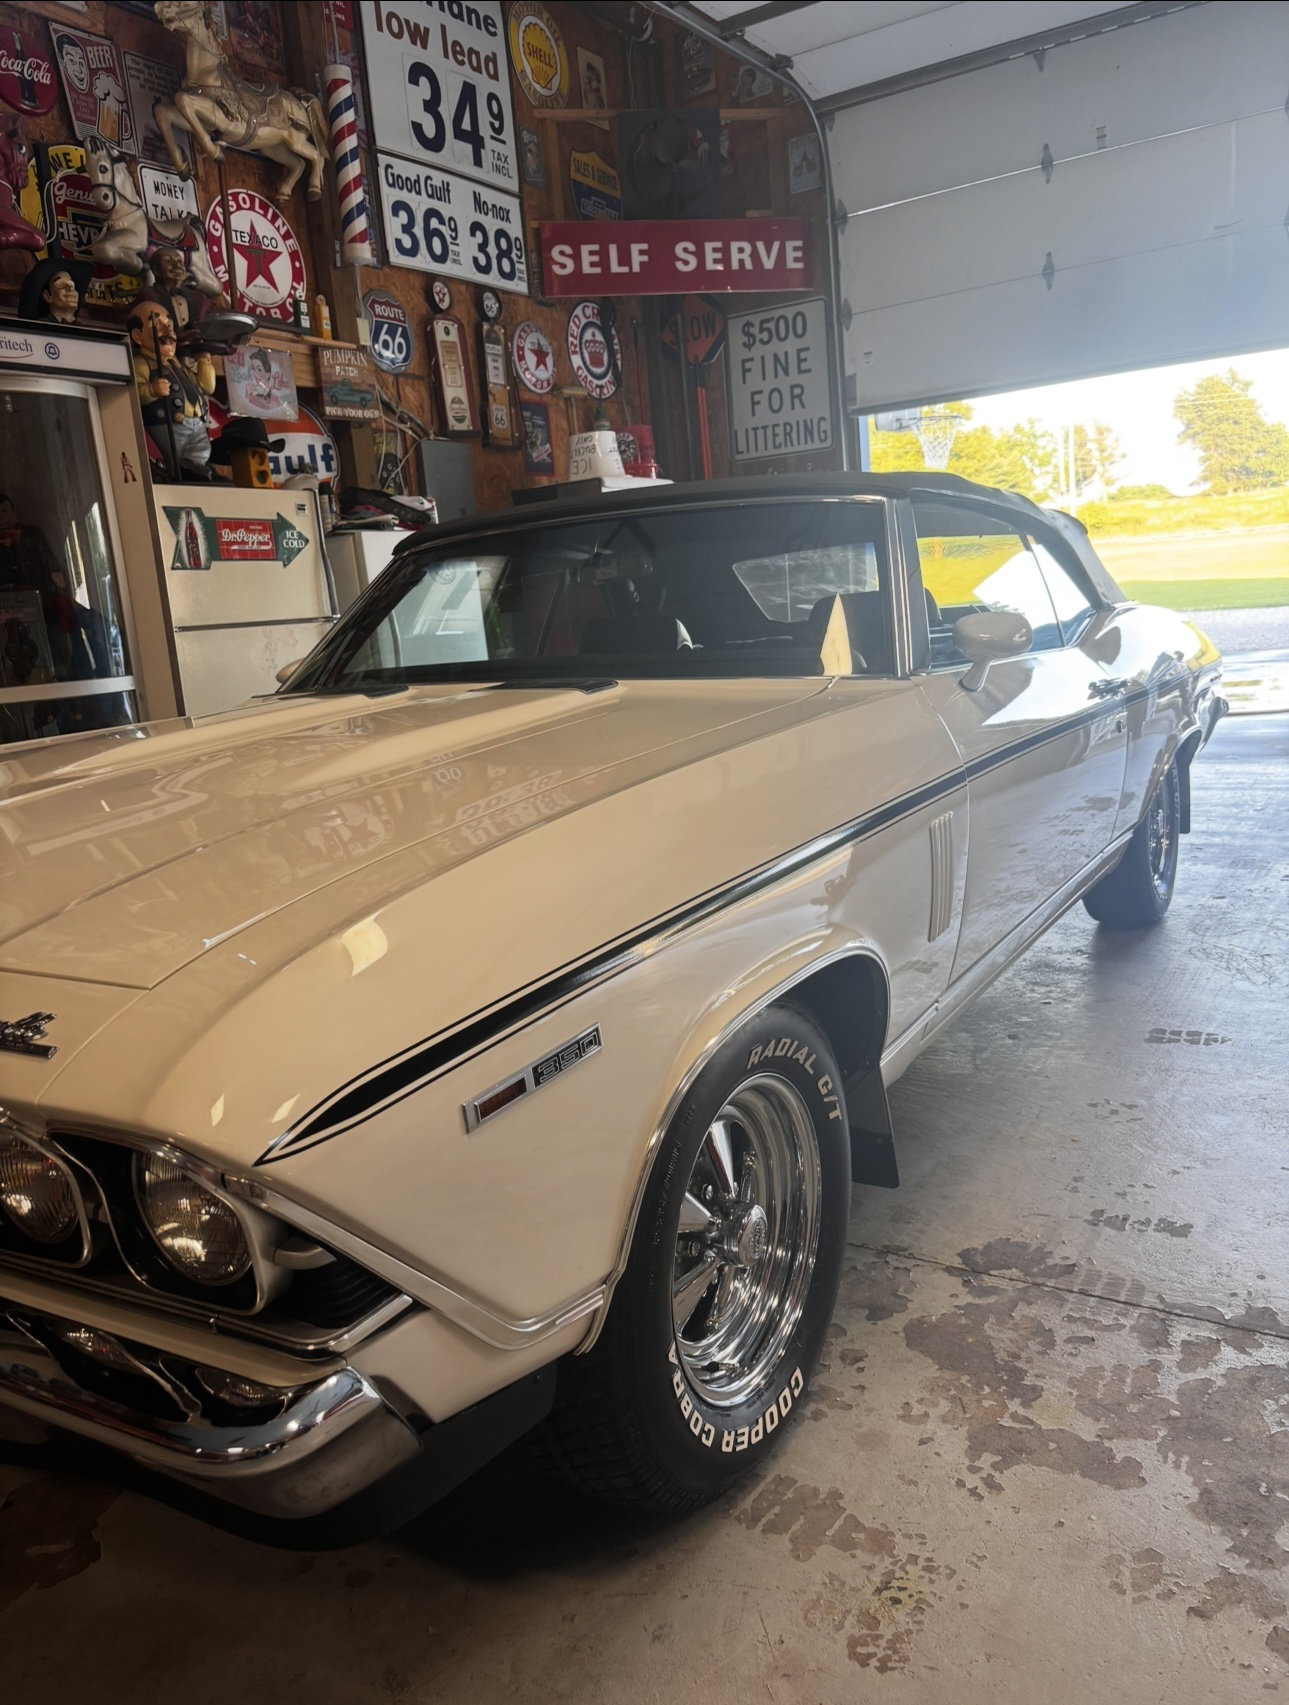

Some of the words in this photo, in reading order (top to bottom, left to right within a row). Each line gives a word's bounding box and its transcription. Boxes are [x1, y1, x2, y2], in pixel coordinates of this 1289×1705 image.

[373, 0, 431, 50] low
[440, 23, 500, 82] lead
[526, 42, 554, 69] SHELL
[86, 46, 114, 70] BEER
[491, 149, 510, 166] TAX
[153, 180, 186, 201] MONEY
[384, 164, 422, 197] Good
[424, 178, 452, 206] Gulf
[152, 203, 192, 221] TALK
[209, 192, 298, 254] GASOLINE
[232, 229, 278, 249] TEXACO
[551, 243, 649, 275] SELF
[674, 240, 804, 272] SERVE
[374, 302, 405, 321] ROUTE
[377, 324, 406, 357] 66
[568, 315, 582, 356] RED
[668, 312, 716, 347] SOW
[741, 310, 808, 352] $500
[323, 349, 368, 368] PUMPKIN
[335, 366, 359, 377] PATCH
[741, 347, 812, 385] FINE
[575, 365, 618, 398] GASOLIN
[326, 406, 343, 417] PICK
[344, 407, 363, 418] YOUR
[750, 383, 806, 417] FOR
[494, 413, 506, 426] 66
[734, 416, 828, 455] LITTERING
[571, 458, 592, 475] ICE
[283, 539, 305, 549] COLD
[285, 530, 299, 539] ICE
[538, 1031, 600, 1084] 350
[745, 1037, 817, 1076] RADIAL
[817, 1073, 843, 1121] G/T
[721, 1366, 804, 1453] COOPER
